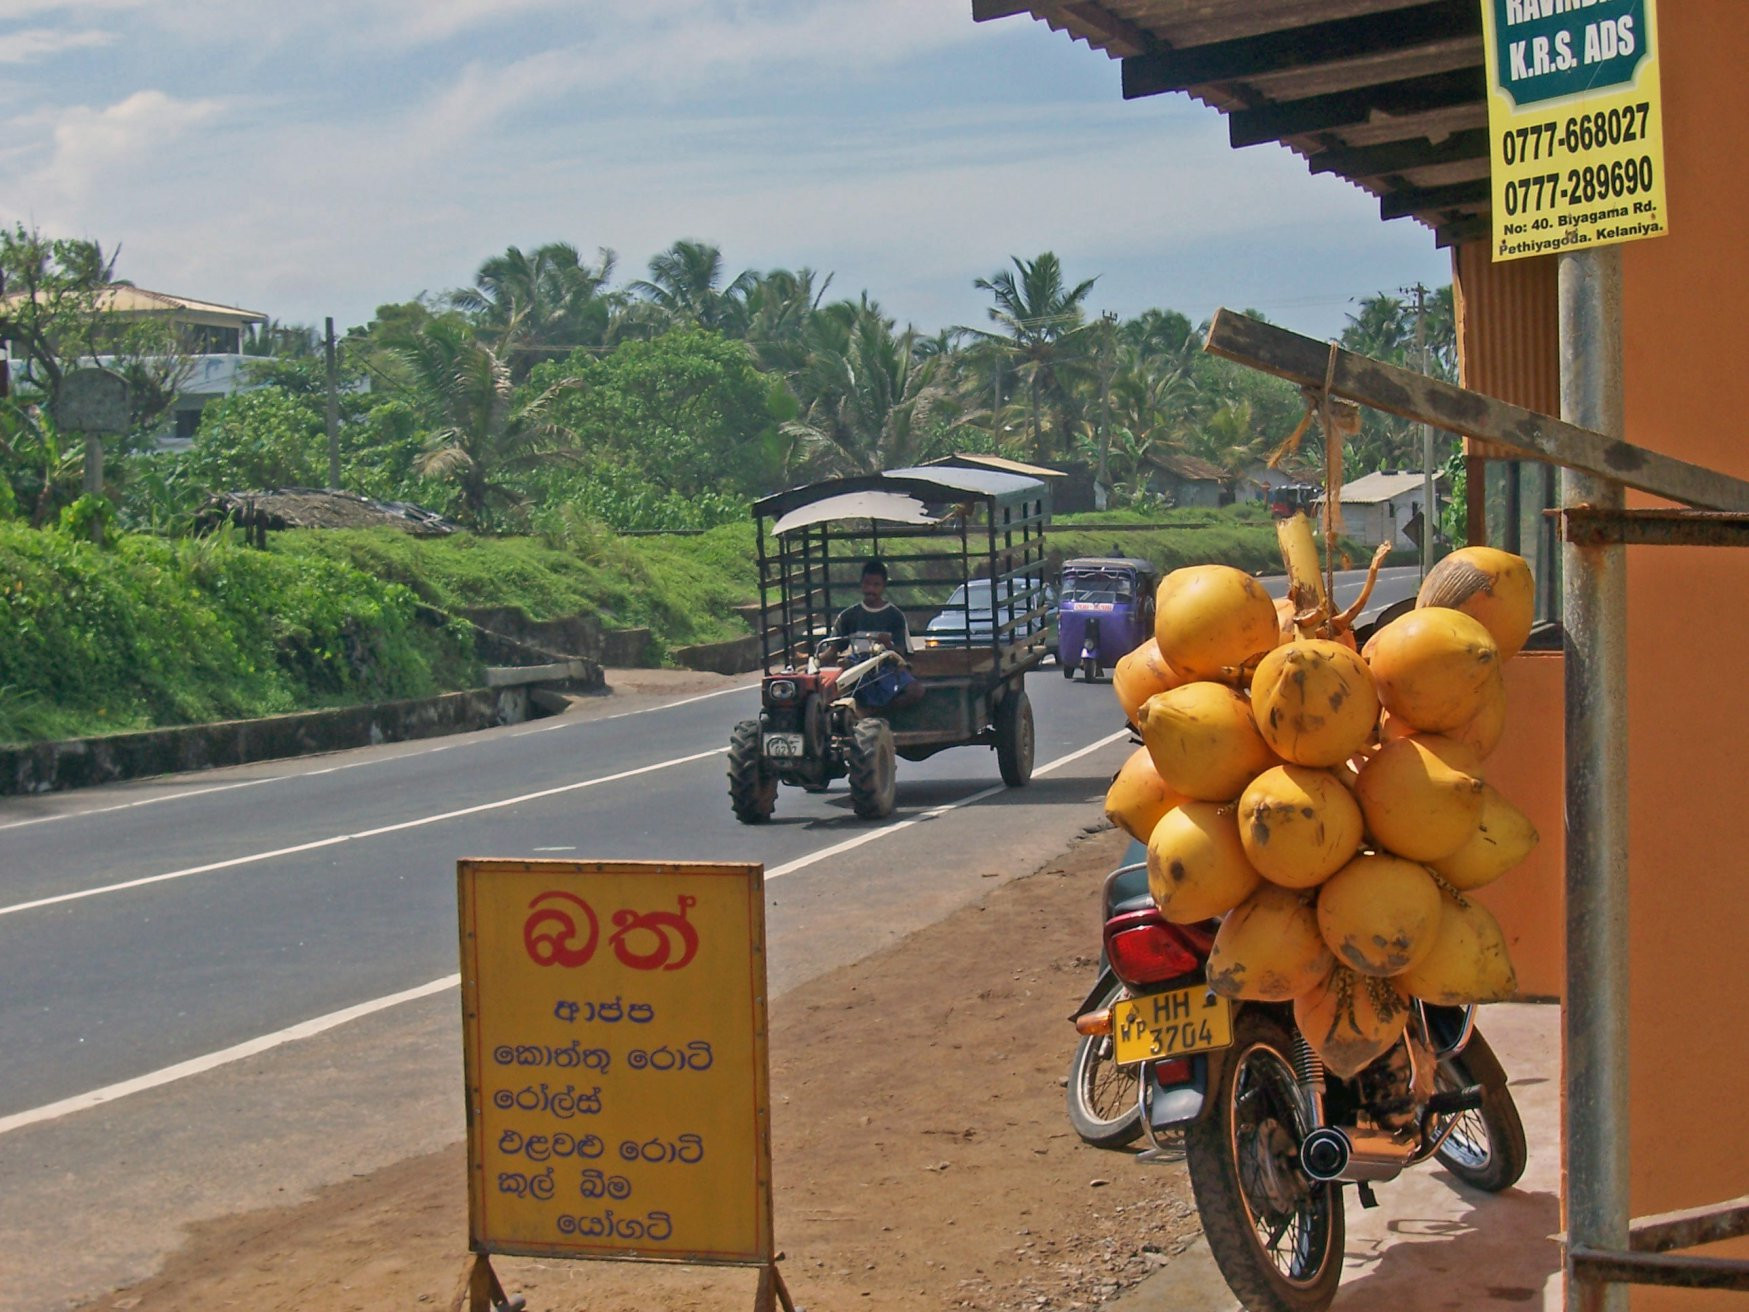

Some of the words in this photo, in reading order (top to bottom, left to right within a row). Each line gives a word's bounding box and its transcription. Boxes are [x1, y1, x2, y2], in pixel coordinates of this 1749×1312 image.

[1509, 30, 1577, 81] K.R.S.
[1584, 14, 1635, 65] ADS
[1503, 101, 1650, 166] 0777-668027
[1504, 155, 1653, 216] 0777-289690
[1503, 223, 1528, 236] No:
[1531, 217, 1554, 231] 40.
[1558, 205, 1629, 227] Biyagama
[1633, 200, 1657, 214] Rd.
[1596, 221, 1664, 241] Kelaniya.
[523, 890, 699, 972] බත්
[1153, 991, 1191, 1024] HH
[1149, 1018, 1213, 1055] 3704
